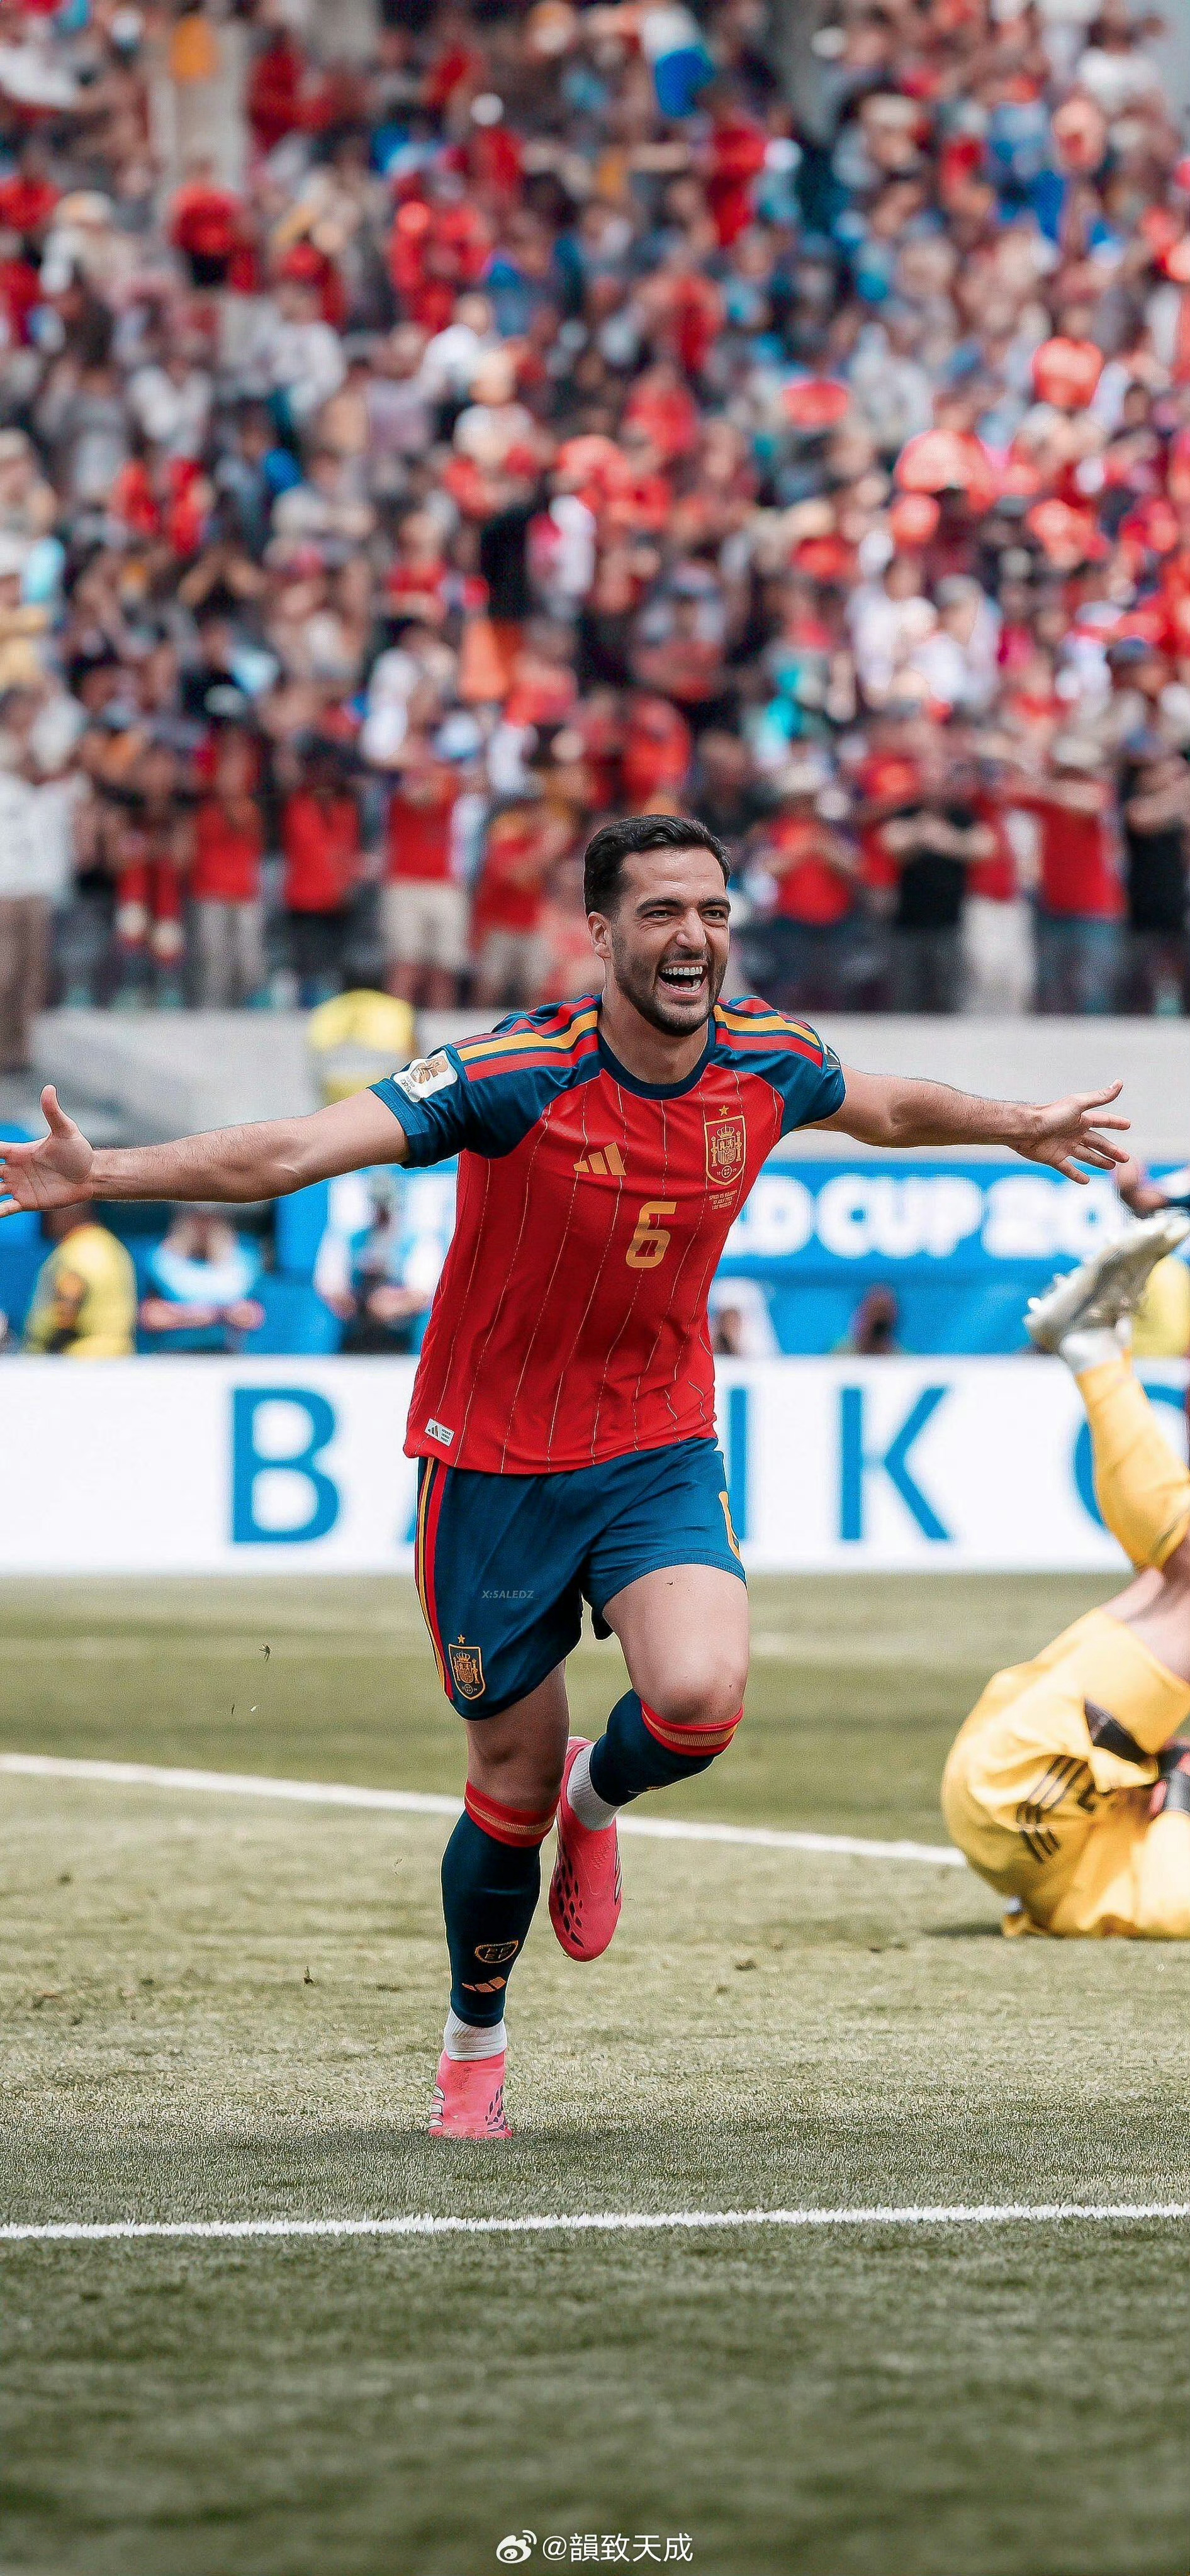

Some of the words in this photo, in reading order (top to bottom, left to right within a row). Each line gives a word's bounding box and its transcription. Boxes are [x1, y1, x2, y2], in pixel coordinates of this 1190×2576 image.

[626, 1201, 676, 1268] 6
[815, 1174, 982, 1257] CUP
[230, 1386, 951, 1542] BK
